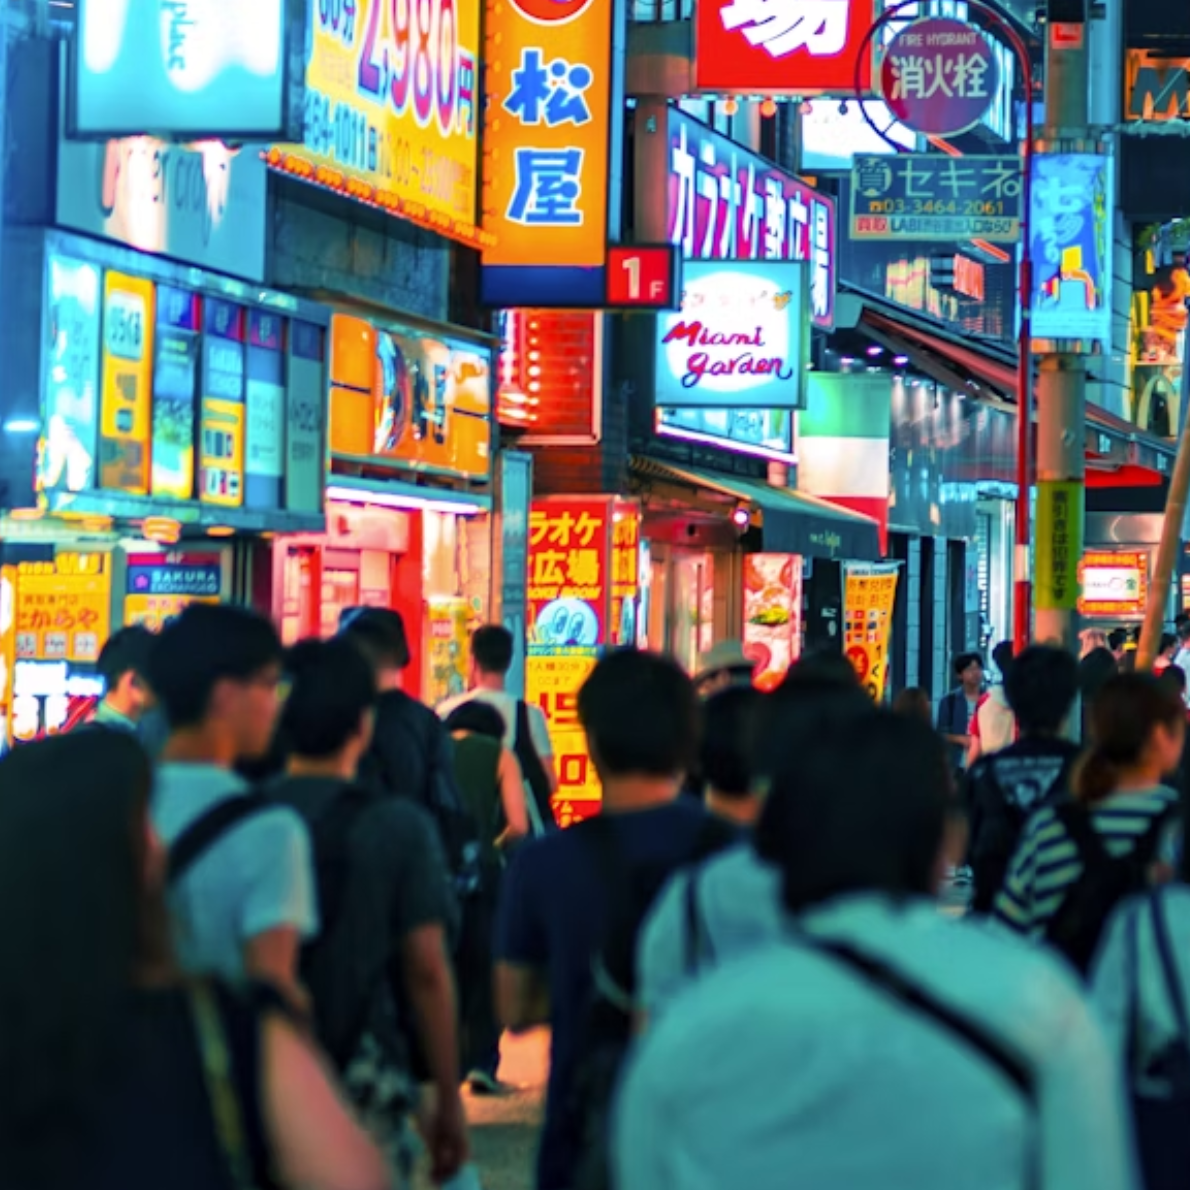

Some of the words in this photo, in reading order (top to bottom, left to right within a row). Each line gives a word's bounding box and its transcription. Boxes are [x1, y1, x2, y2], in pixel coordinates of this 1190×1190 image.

[898, 31, 924, 47] FIRE
[926, 31, 977, 47] HYDRANT
[890, 52, 989, 101] 消火栓
[503, 46, 593, 225] 松屋
[897, 159, 1022, 199] セキネ
[884, 199, 1004, 215] 03-3464-2061
[621, 256, 664, 299] 1F
[661, 321, 766, 347] Miami
[151, 570, 217, 583] SAKURA
[526, 548, 600, 586] 広場
